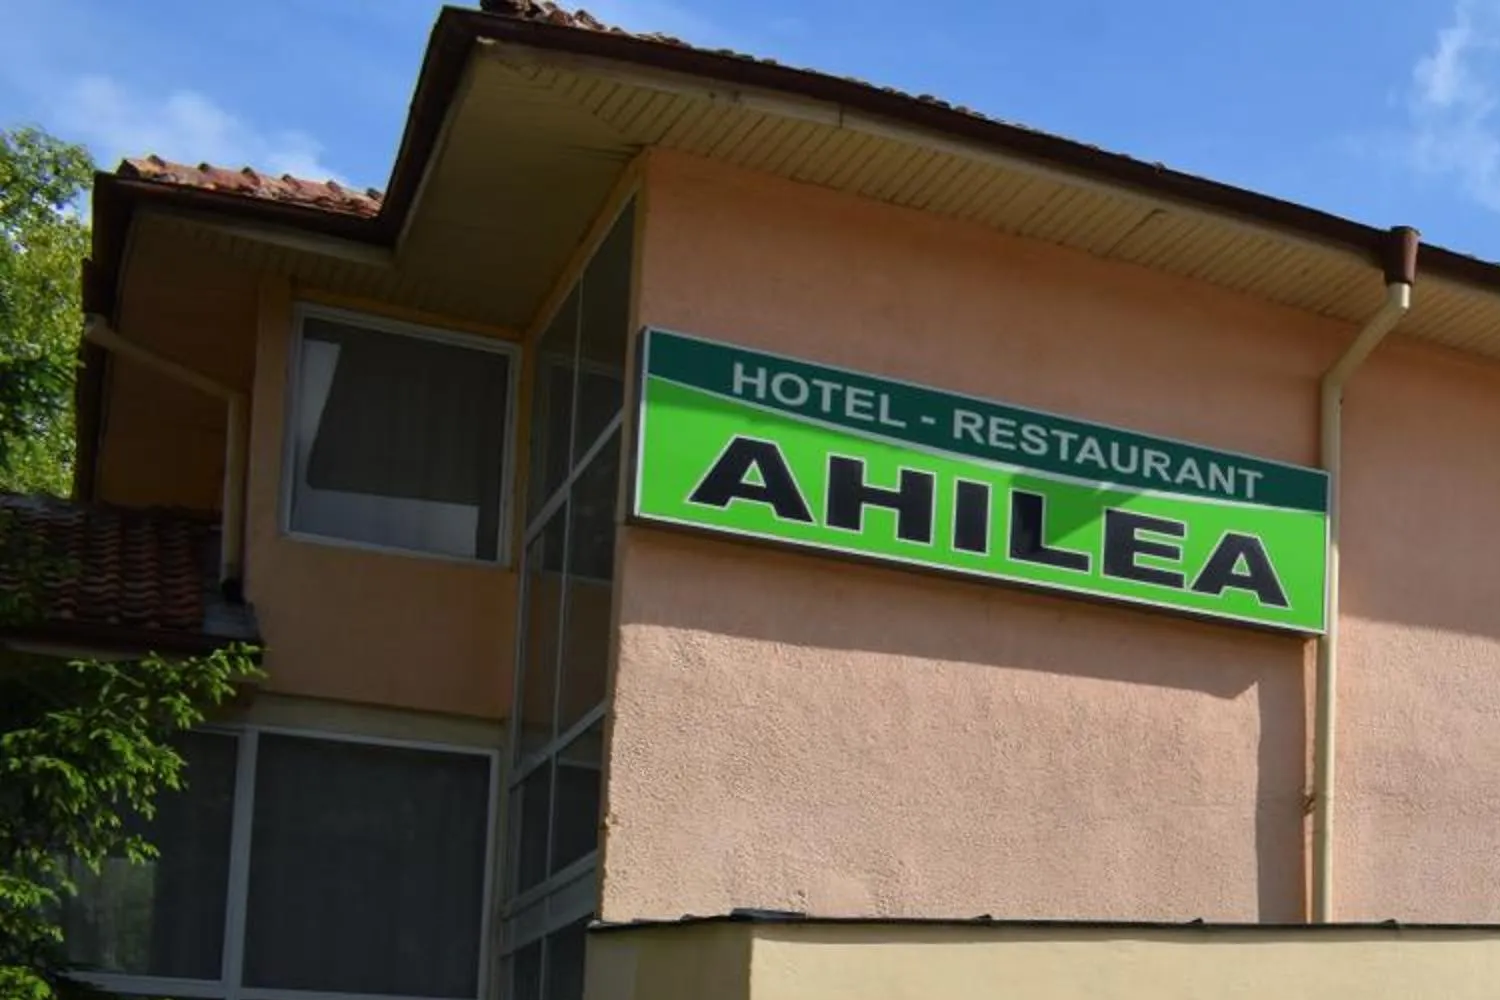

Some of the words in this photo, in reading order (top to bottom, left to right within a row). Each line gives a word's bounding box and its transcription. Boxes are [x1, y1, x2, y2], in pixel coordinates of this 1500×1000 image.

[732, 362, 906, 428] HOTEL
[953, 409, 1263, 498] RESTAURANT
[686, 434, 1293, 611] AHILEA
